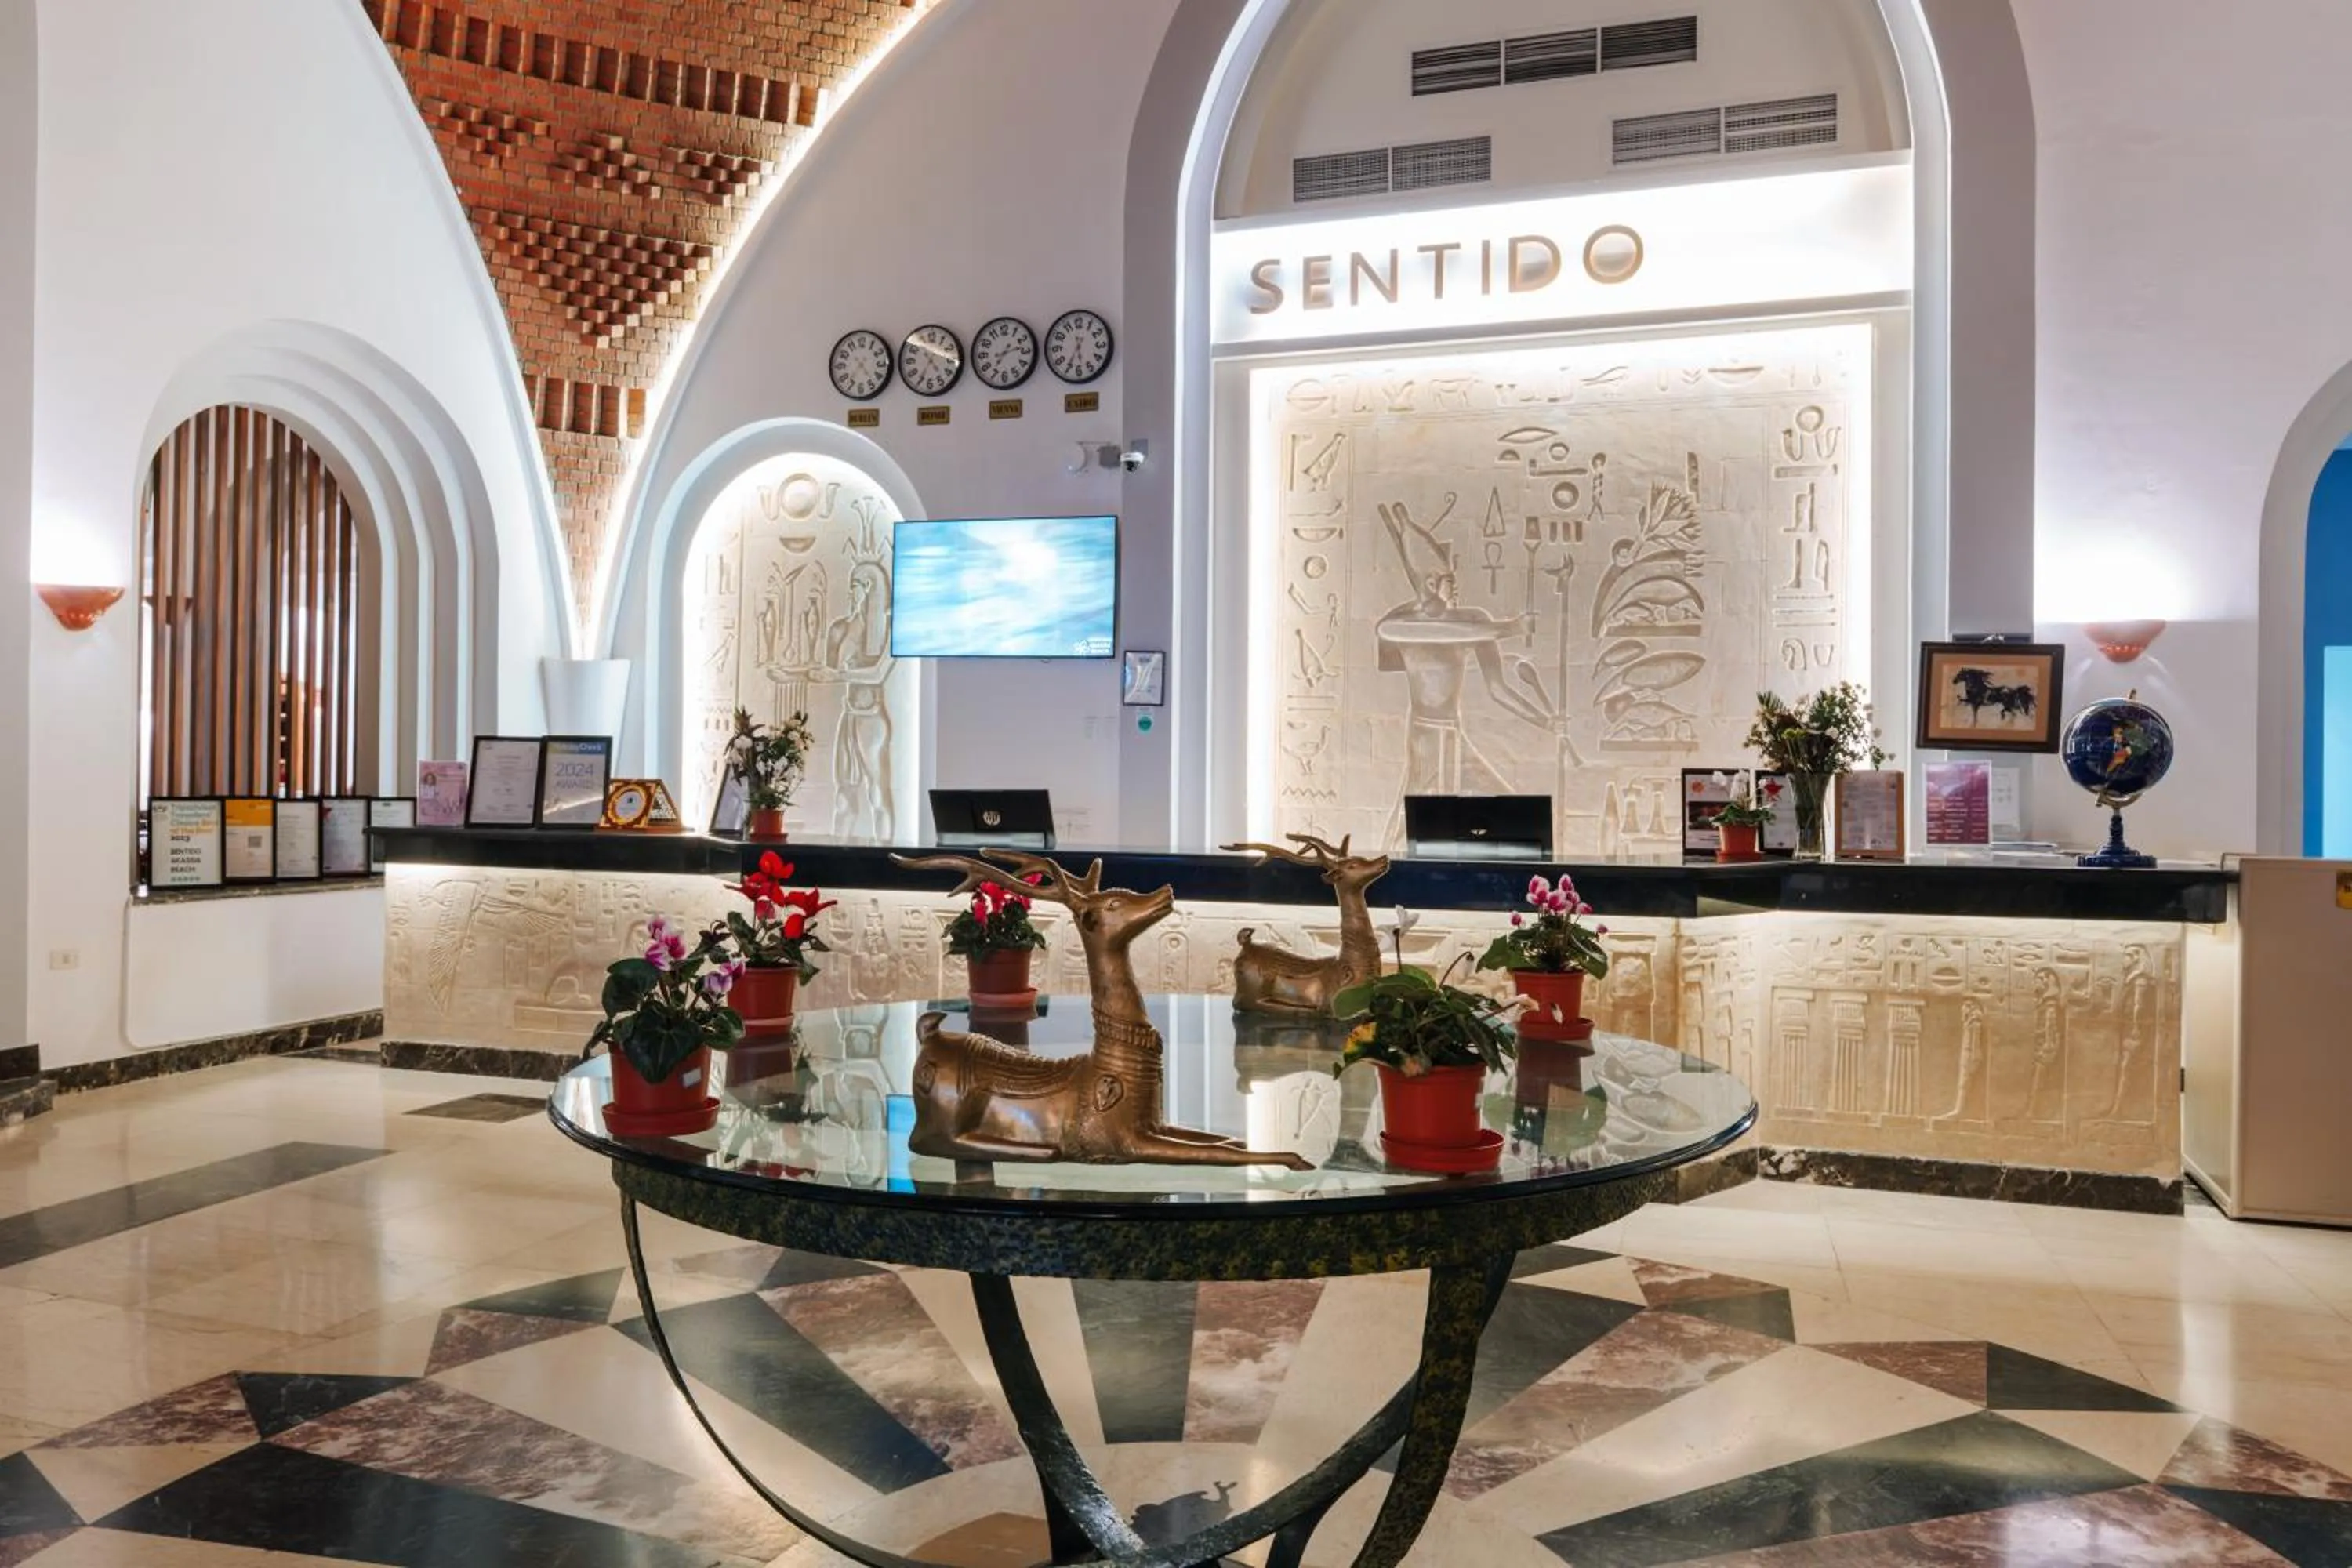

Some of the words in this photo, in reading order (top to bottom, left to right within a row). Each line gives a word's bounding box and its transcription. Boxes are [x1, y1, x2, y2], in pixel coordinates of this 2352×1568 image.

[1250, 224, 1644, 314] SENTIDO
[1074, 317, 1083, 328] 12
[1087, 320, 1093, 331] 1
[1000, 324, 1008, 336] 12
[1011, 327, 1018, 337] 1
[1092, 328, 1102, 339] 2
[1017, 334, 1027, 344] 2
[1052, 345, 1062, 354] 9
[978, 351, 989, 360] 9
[1055, 355, 1065, 366] 8
[1094, 353, 1102, 361] 4
[982, 362, 992, 372] 8
[1011, 366, 1019, 378] 5
[1065, 363, 1073, 373] 7
[1075, 365, 1083, 376] 6
[1086, 361, 1094, 372] 5
[991, 368, 999, 379] 7
[1001, 371, 1007, 383] 6
[556, 763, 594, 777] 2024
